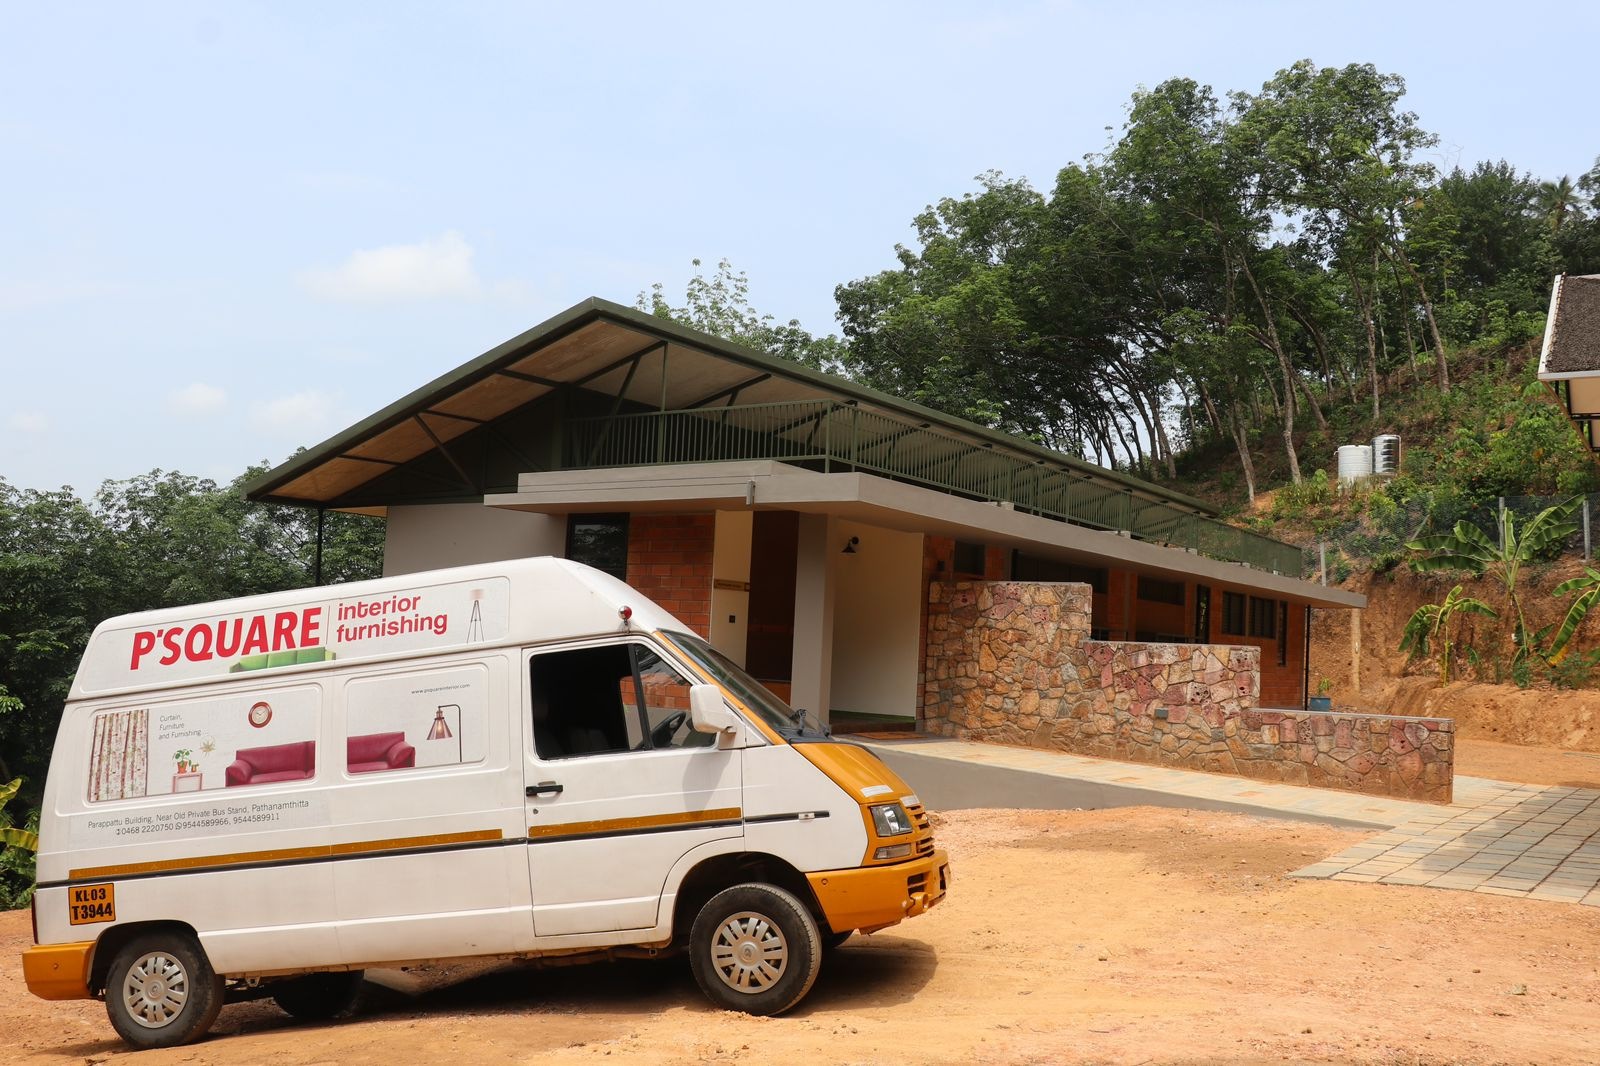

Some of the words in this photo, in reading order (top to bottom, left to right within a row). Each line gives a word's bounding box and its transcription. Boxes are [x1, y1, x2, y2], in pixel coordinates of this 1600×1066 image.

[337, 596, 421, 621] interior
[130, 606, 322, 671] P'SQUARE
[336, 614, 448, 643] furnishing
[160, 714, 182, 722] Curtain,
[160, 723, 184, 731] Furniture
[88, 819, 122, 829] Parappattu
[124, 815, 153, 825] Building,
[156, 813, 172, 821] Near
[173, 811, 186, 820] Old
[187, 809, 211, 818] Private
[212, 808, 226, 816] Bus
[227, 806, 249, 814] Stand,
[252, 800, 309, 812] Pathanamthitta
[121, 826, 140, 835] 0468
[141, 823, 174, 833] 2220750
[233, 812, 280, 824] 9544589911
[71, 902, 113, 920] T3944
